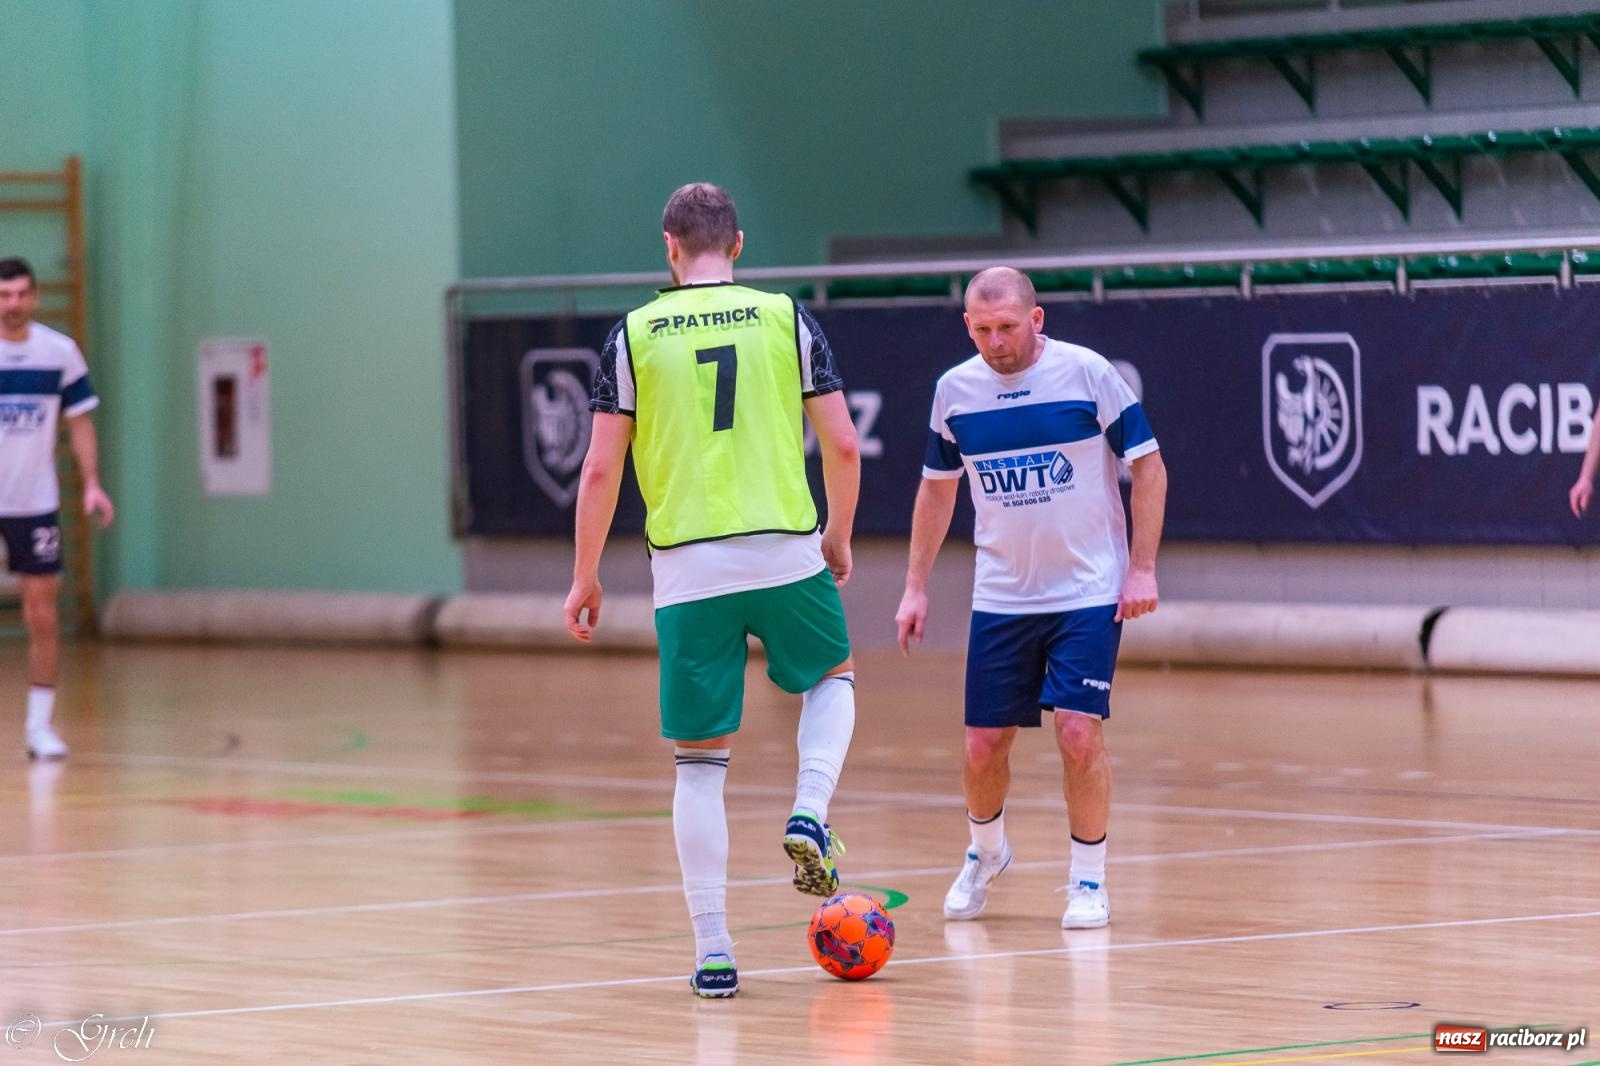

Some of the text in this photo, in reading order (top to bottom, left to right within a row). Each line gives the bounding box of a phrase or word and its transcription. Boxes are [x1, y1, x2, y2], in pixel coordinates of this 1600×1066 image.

[673, 306, 760, 329] PATRICK
[695, 344, 738, 432] 7
[1416, 382, 1594, 456] RACIB
[974, 453, 1052, 471] INSTAL
[978, 463, 1051, 494] DWT
